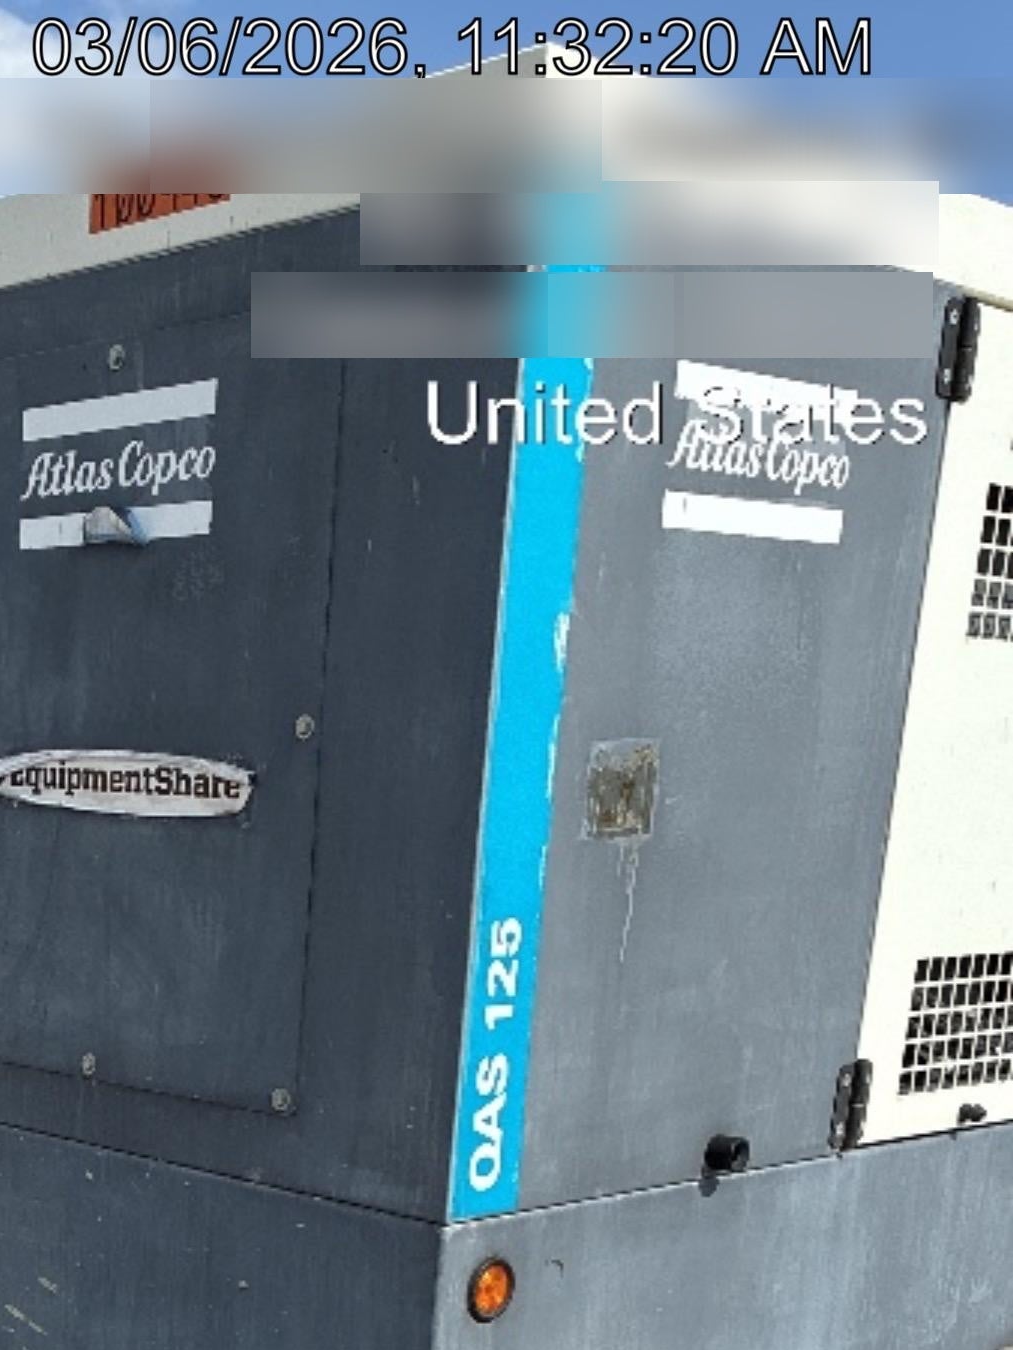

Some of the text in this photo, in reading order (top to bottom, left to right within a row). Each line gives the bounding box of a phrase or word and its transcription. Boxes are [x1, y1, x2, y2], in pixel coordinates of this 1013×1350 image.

[19, 440, 216, 501] Atlas Copco
[766, 427, 851, 497] Copco
[10, 759, 242, 800] EquipmentShare
[468, 916, 523, 1193] QAS 125
